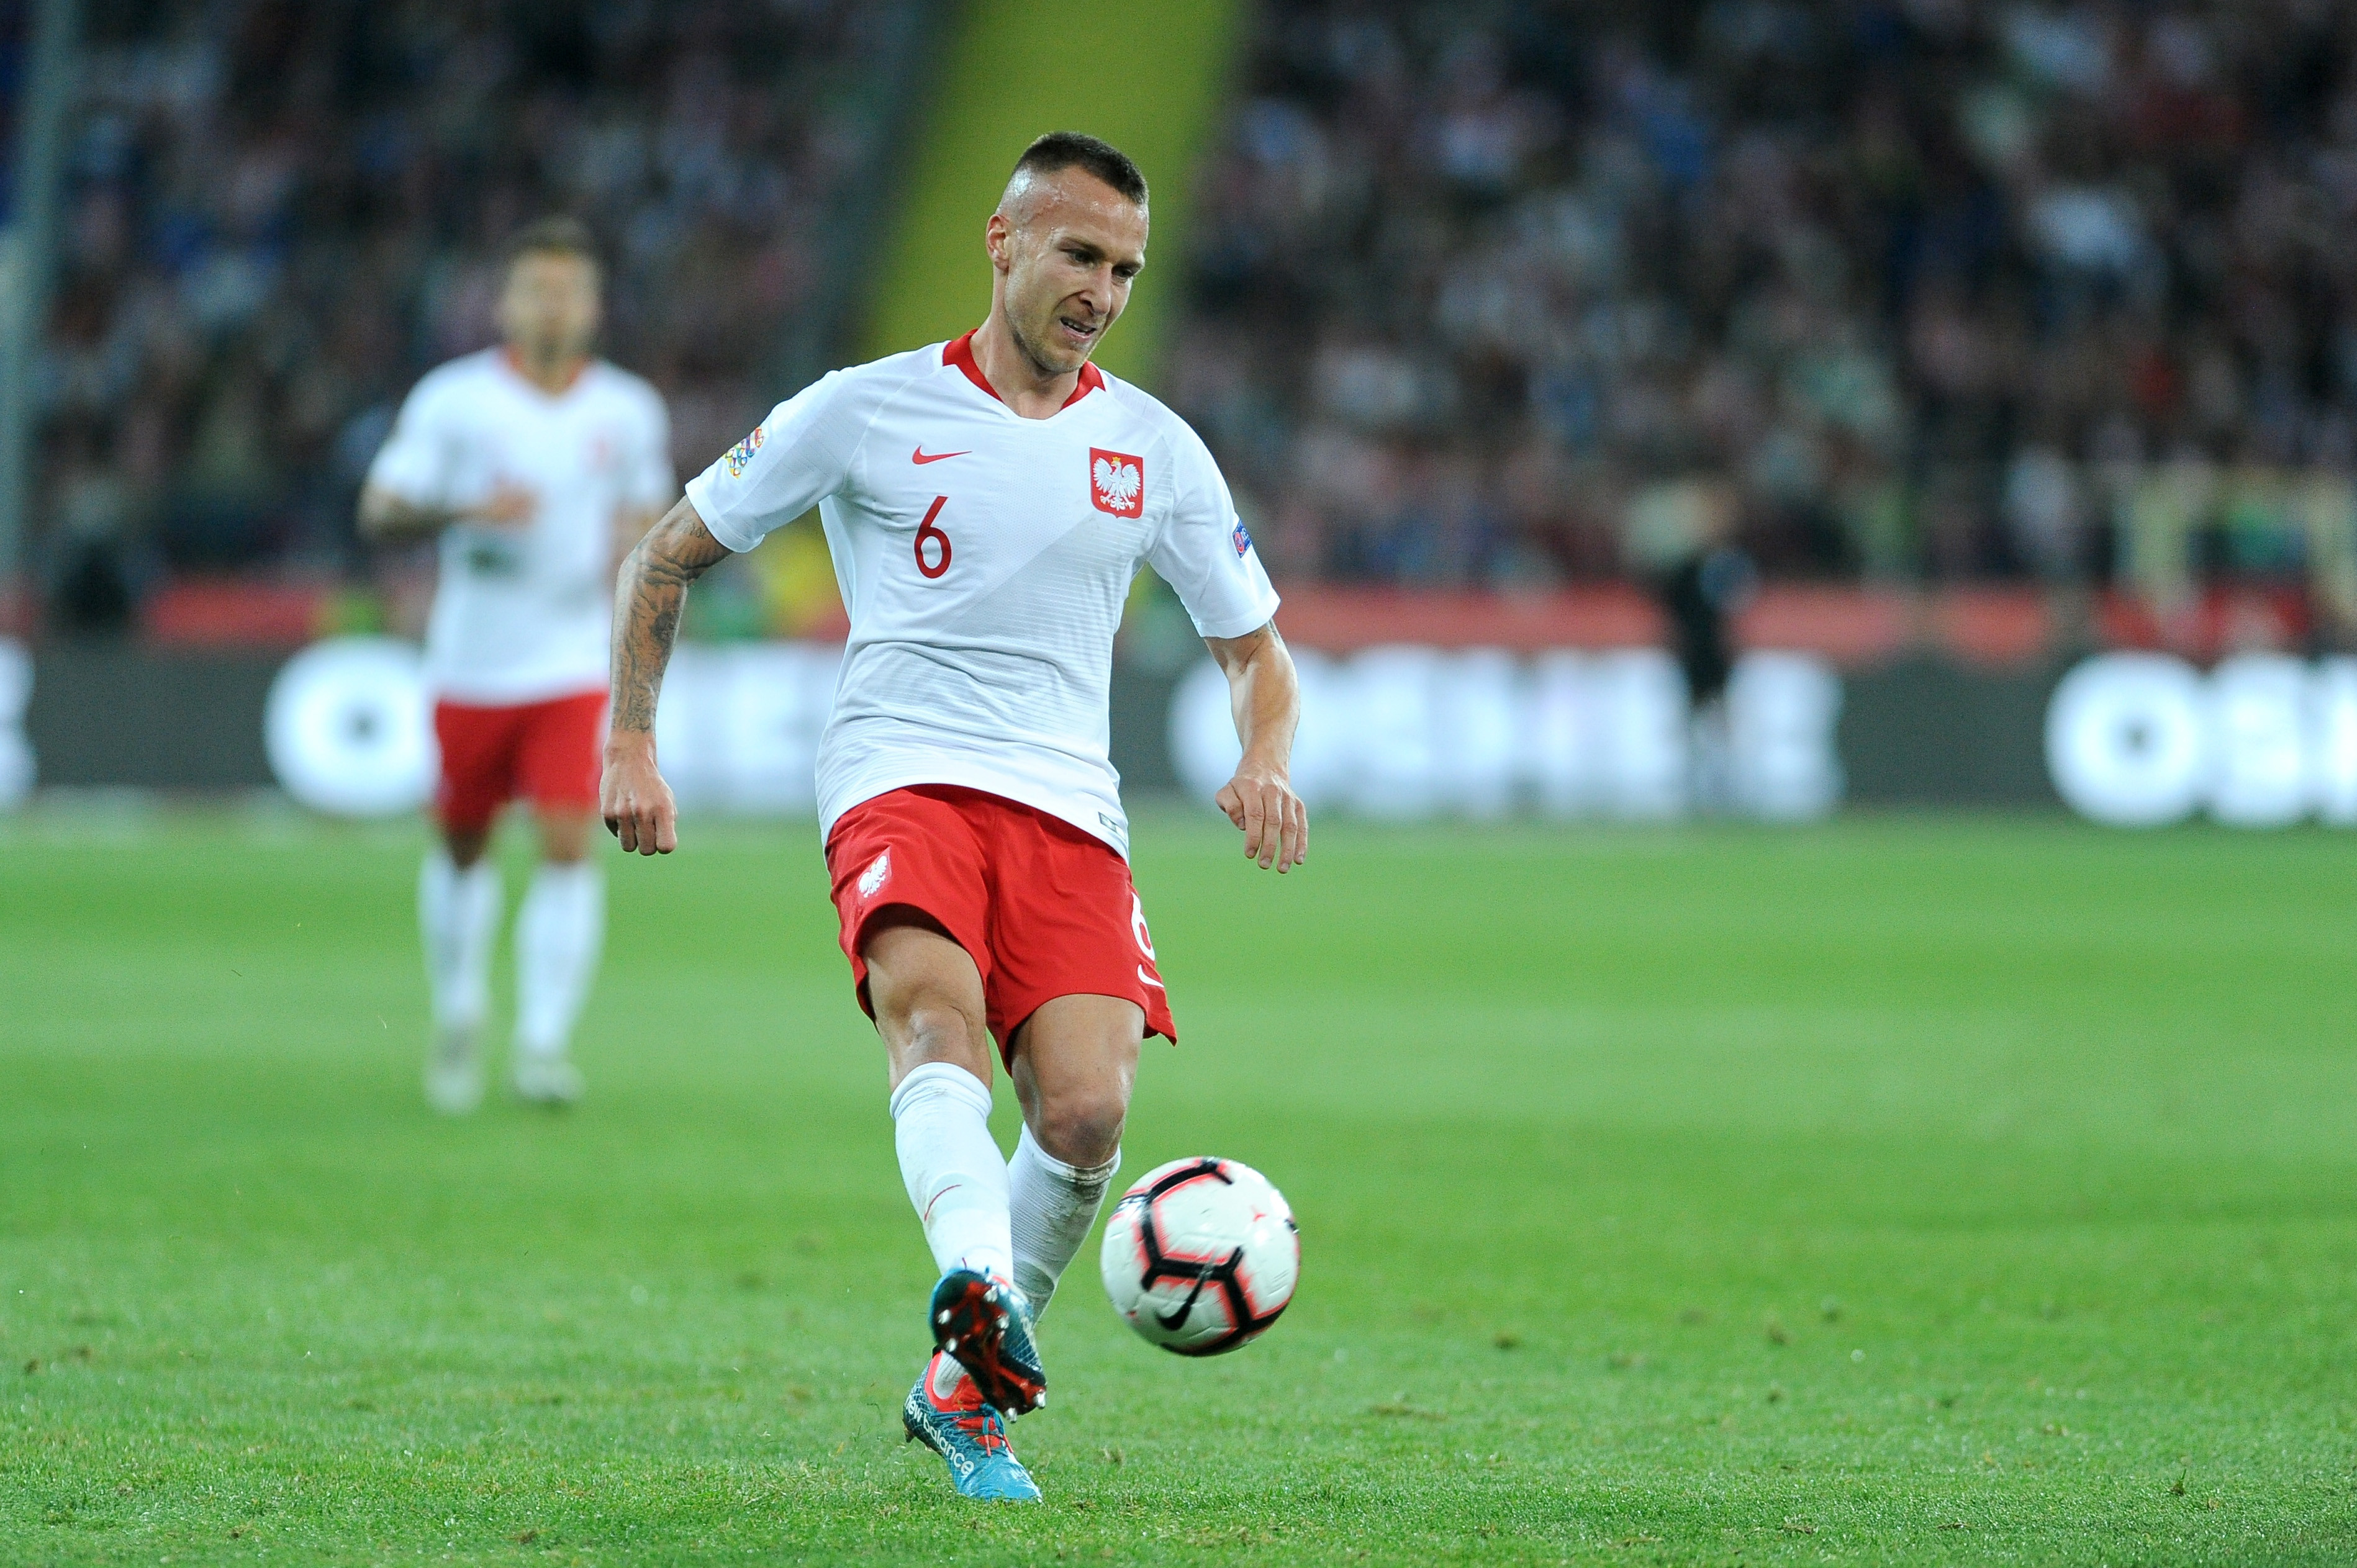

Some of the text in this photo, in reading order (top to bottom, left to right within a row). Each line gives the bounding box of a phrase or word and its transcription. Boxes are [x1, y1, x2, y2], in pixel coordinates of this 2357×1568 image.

[914, 495, 952, 579] 6
[904, 1394, 974, 1476] new balance
